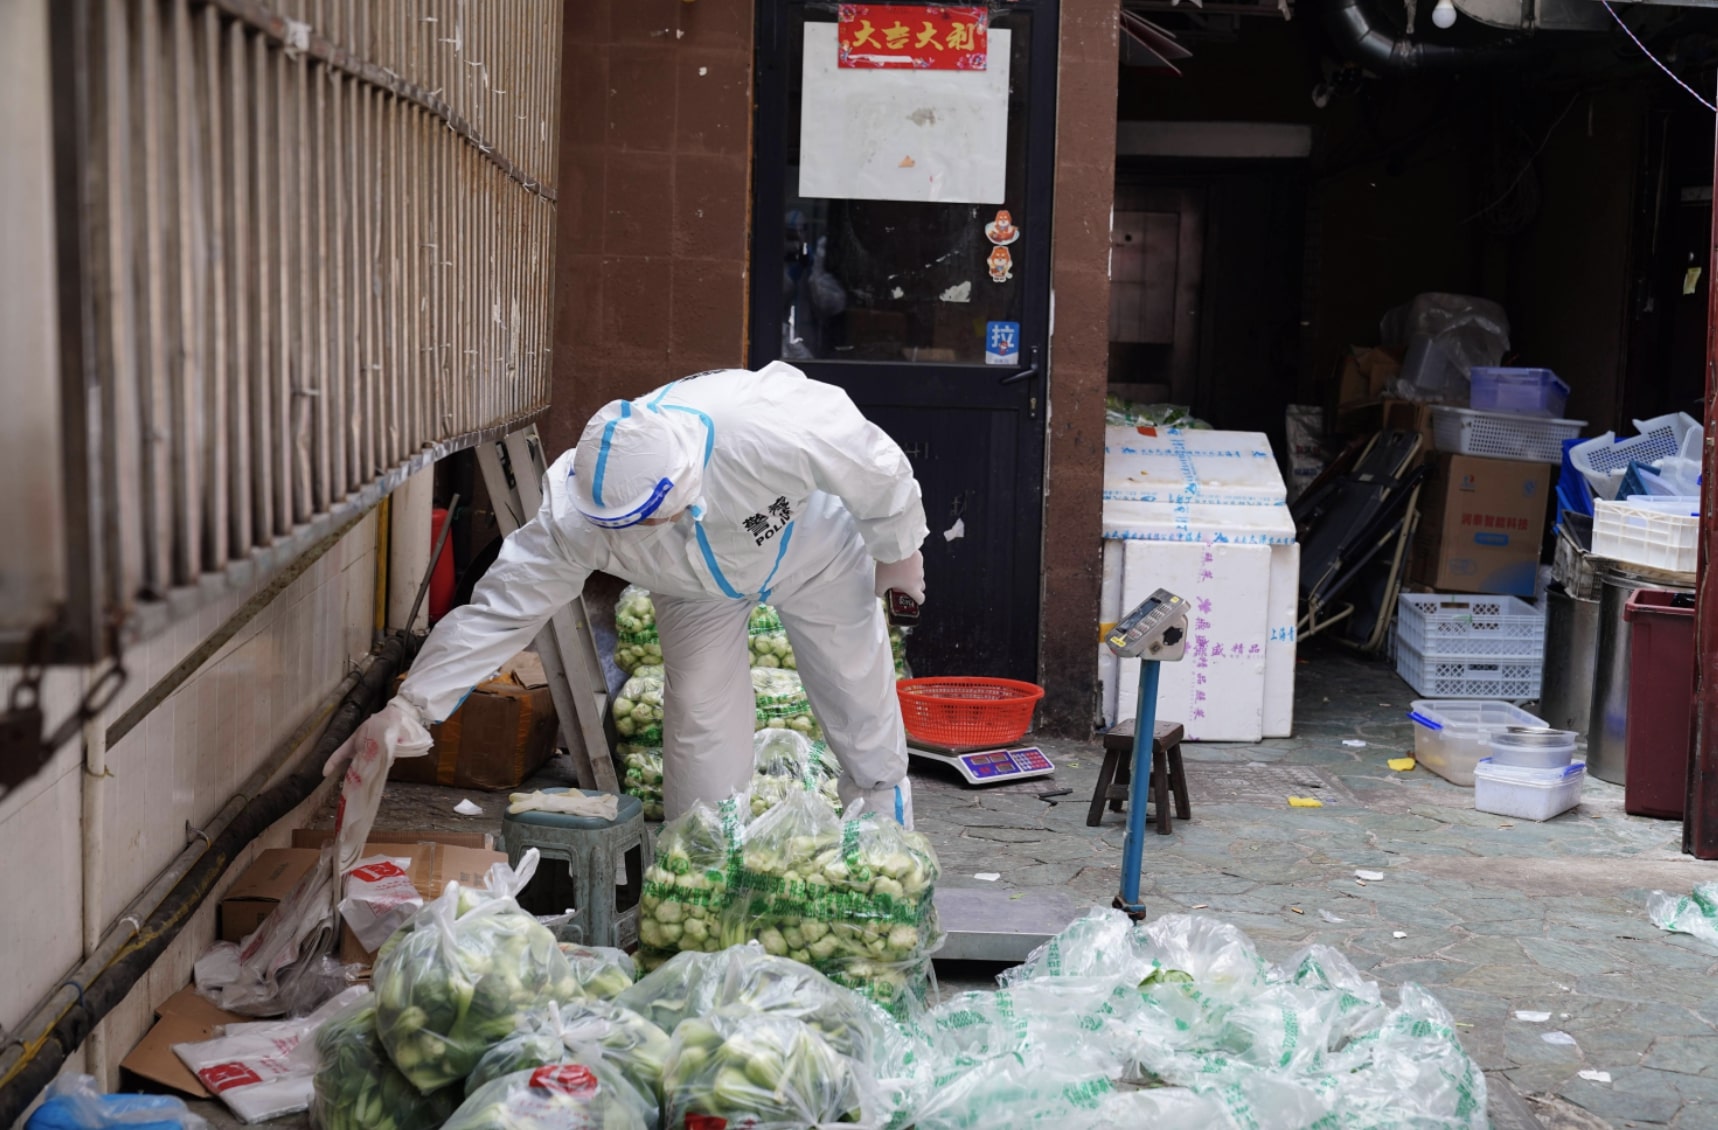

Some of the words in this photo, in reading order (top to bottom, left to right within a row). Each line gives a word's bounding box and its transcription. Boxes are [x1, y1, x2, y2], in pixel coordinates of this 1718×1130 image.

[852, 19, 976, 51] 大吉大利
[991, 324, 1015, 348] 拉
[742, 495, 790, 537] 警察
[1270, 626, 1294, 642] 上海青
